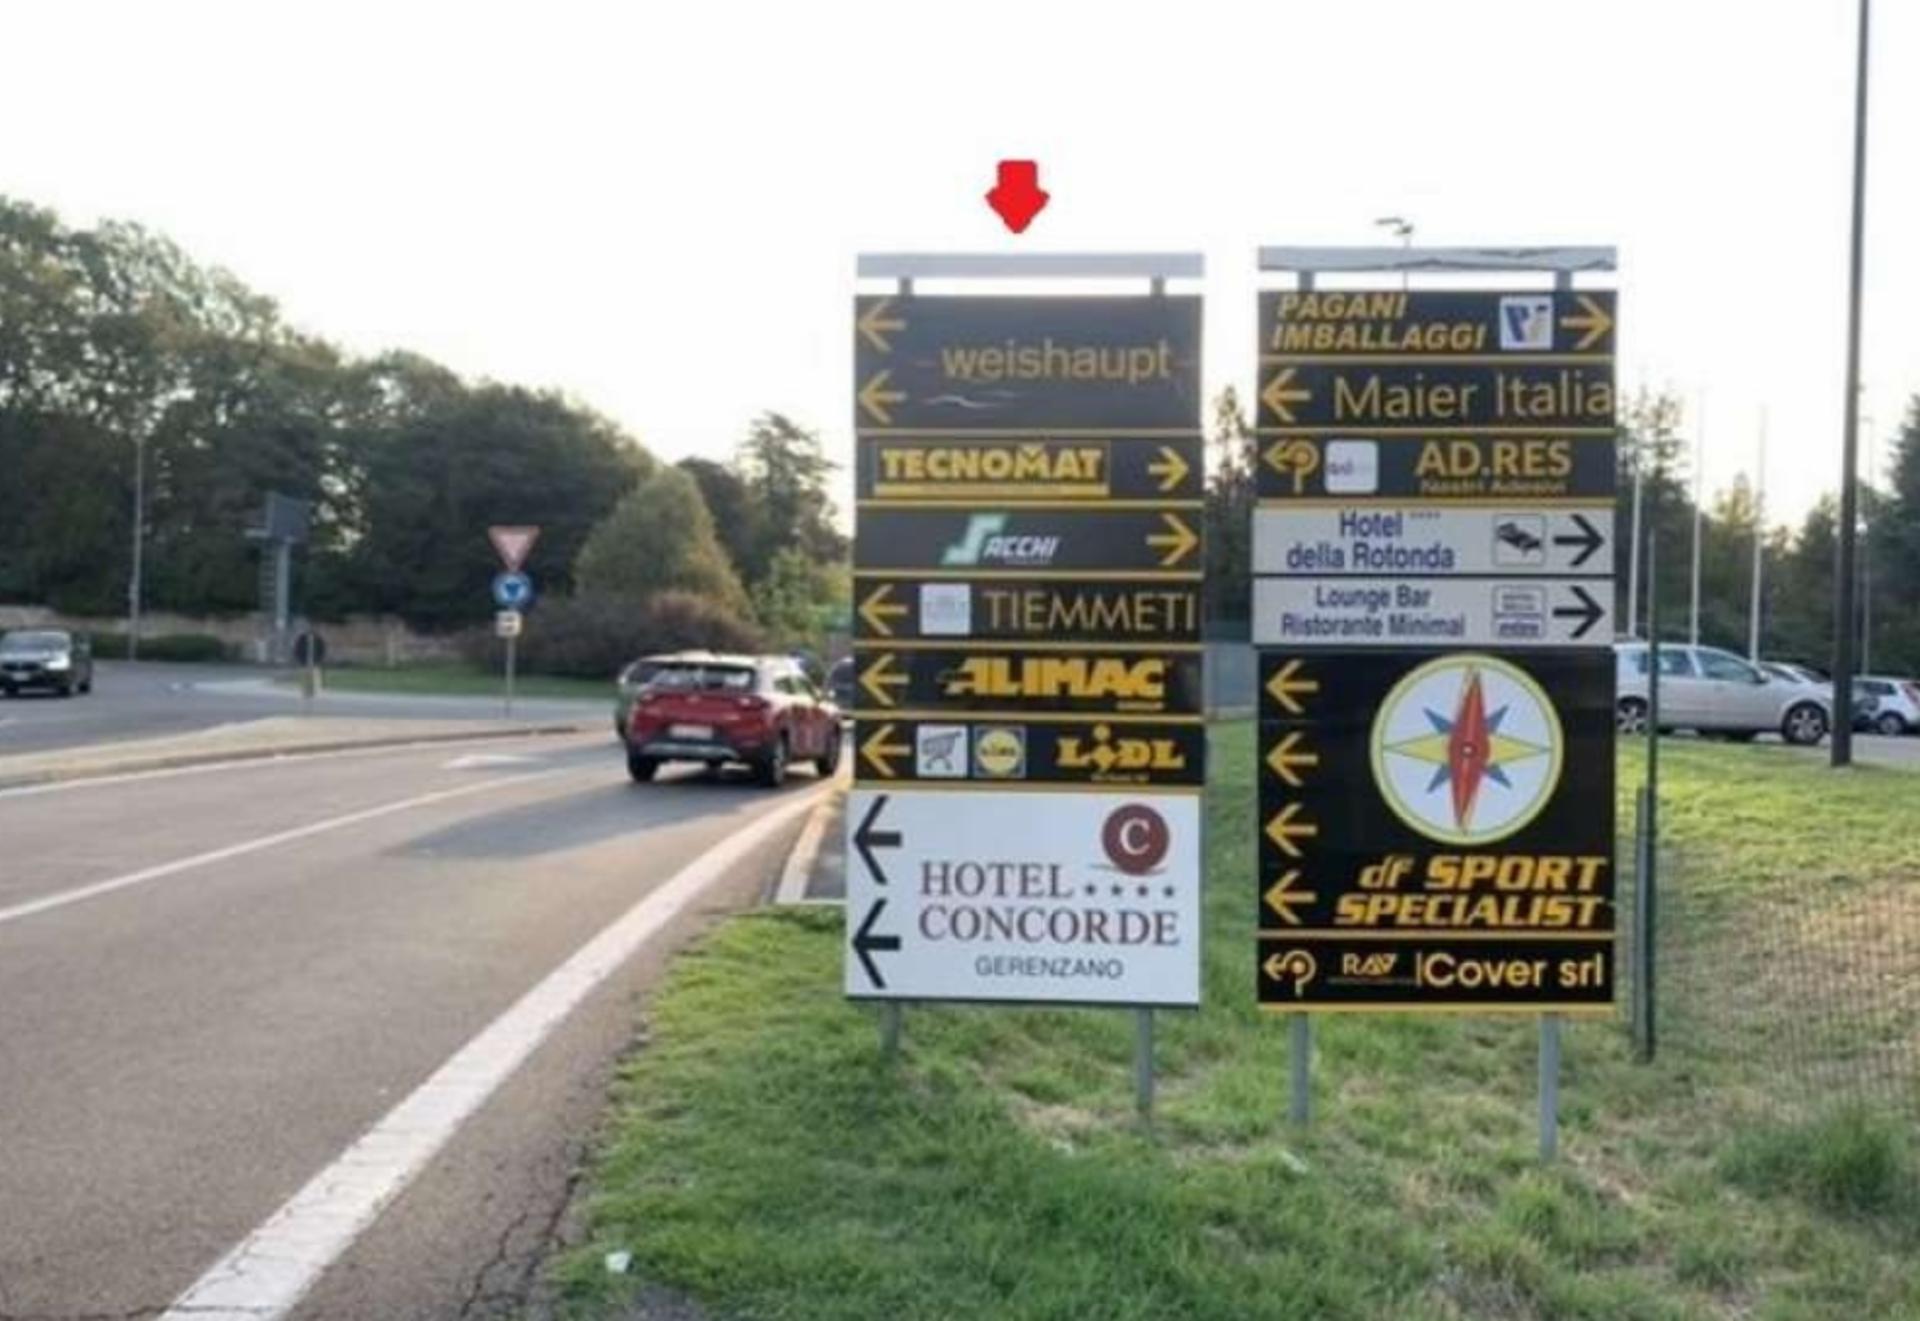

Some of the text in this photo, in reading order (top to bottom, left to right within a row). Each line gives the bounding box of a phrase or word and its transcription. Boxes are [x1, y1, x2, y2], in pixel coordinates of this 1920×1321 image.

[1277, 293, 1408, 320] PAGANI
[1271, 322, 1488, 350] IMBALLAGGI
[941, 337, 1172, 385] weishaupt
[1333, 369, 1614, 419] Maier Italia
[881, 444, 1103, 480] TECNOMAT
[1415, 440, 1573, 477] AD.RES
[1340, 511, 1403, 537] Hotel
[1286, 541, 1455, 568] della Rotonda
[982, 590, 1196, 632] TIEMMETI
[1315, 585, 1431, 613] Lounge Bar
[1281, 613, 1466, 636] Ristorante Minimal
[945, 657, 1165, 697] ALIMAC
[1120, 818, 1151, 855] C
[920, 860, 1074, 898] HOTEL
[1424, 855, 1607, 890] SPORT
[918, 904, 1181, 948] CONCORDE
[1334, 894, 1605, 926] SPECIALIST
[975, 954, 1125, 980] GERENZANO
[1559, 952, 1604, 987] srl
